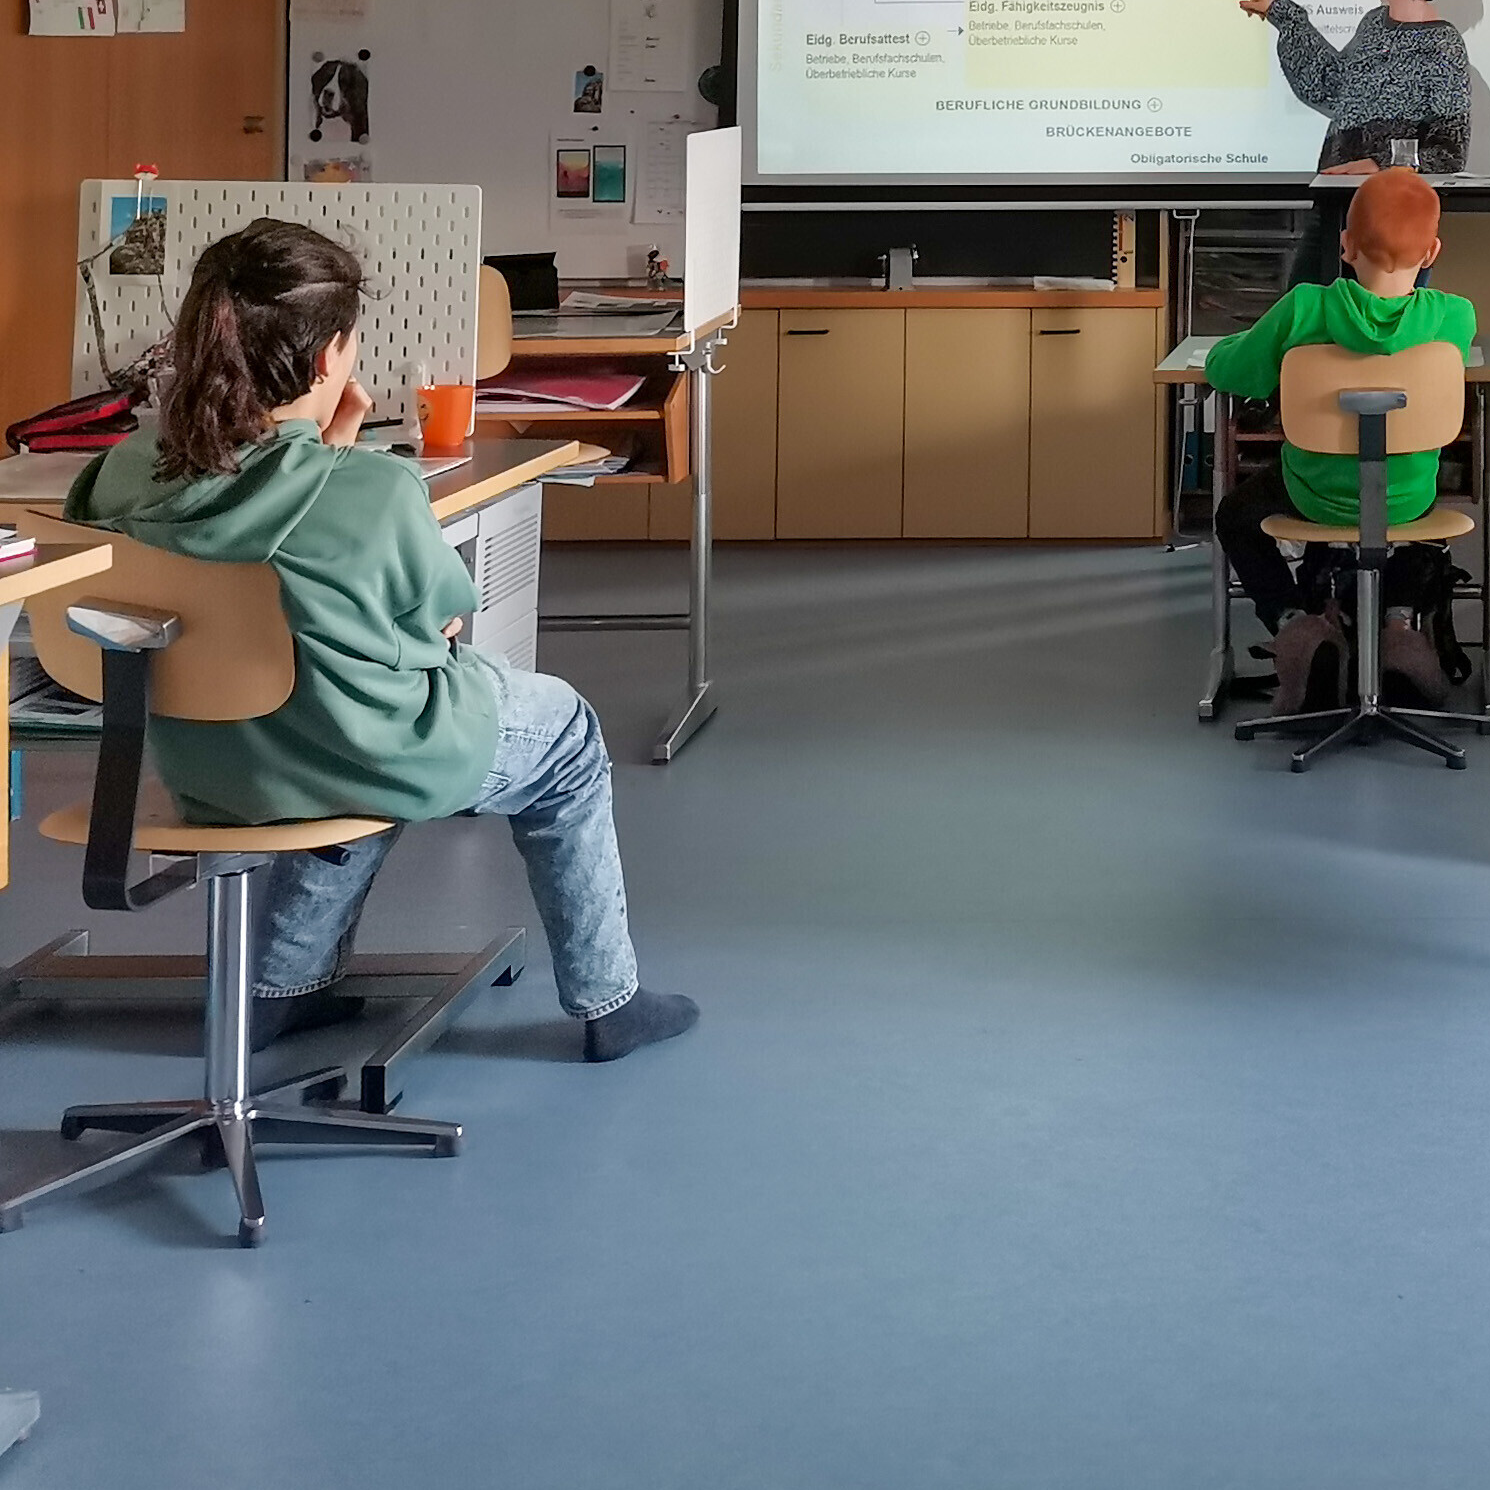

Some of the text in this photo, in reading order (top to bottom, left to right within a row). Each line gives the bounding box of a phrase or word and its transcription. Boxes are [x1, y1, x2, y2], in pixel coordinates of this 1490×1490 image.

[969, 0, 998, 14] Eidg.
[1316, 4, 1364, 15] Ausweis
[806, 33, 910, 47] Eidg. Berufsattest
[1050, 35, 1078, 46] Kurse
[887, 67, 917, 79] Kurse
[936, 99, 1142, 111] BERUFLICHE GRUNDBILDUNG
[1046, 125, 1192, 137] BRÜCKENANGEBOTE
[1130, 153, 1269, 166] Obligatorische Schule
